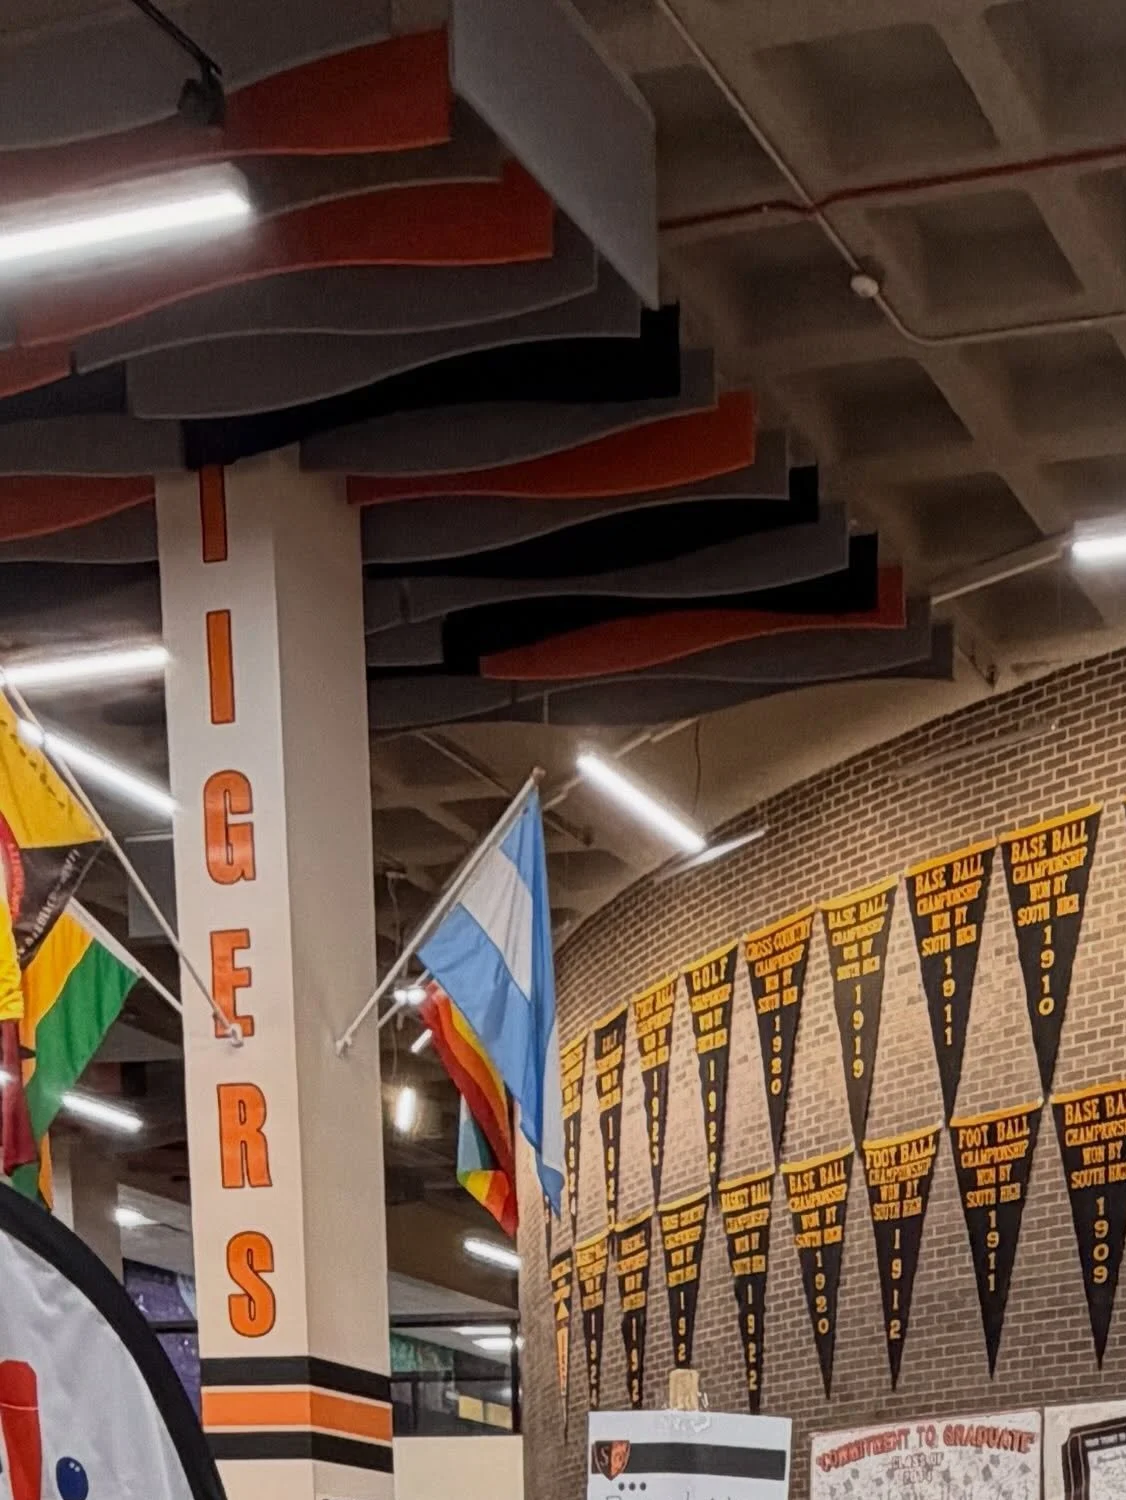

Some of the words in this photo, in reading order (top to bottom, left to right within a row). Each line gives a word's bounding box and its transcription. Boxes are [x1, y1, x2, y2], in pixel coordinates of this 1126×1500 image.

[1011, 833, 1047, 864] BASE
[1052, 820, 1088, 853] BALL
[915, 866, 946, 897] BASE
[952, 854, 984, 884] BALL
[1013, 847, 1087, 885] CHAMPIONSHIP
[917, 880, 982, 916] CHAMPIONSHIP
[1054, 874, 1067, 896] BY
[859, 893, 888, 922] BALL
[1018, 902, 1050, 926] SOUTH
[922, 933, 950, 956] SOUTH
[692, 957, 728, 992] GOLF
[1064, 1098, 1100, 1126] BASE
[959, 1125, 989, 1150] FOOT
[997, 1116, 1030, 1143] BALL
[865, 1147, 897, 1170] FOOT
[900, 1135, 936, 1165] BALL
[961, 1139, 1029, 1169] CHAMPIONSHIP
[1082, 1144, 1105, 1166] WON
[1108, 1141, 1123, 1162] BY
[789, 1171, 816, 1195] BASE
[820, 1159, 847, 1185] BALL
[869, 1156, 932, 1187] CHAMPIONSHIP
[999, 1164, 1012, 1182] BY
[1071, 1168, 1105, 1190] SOUTH
[966, 1188, 996, 1209] SOUTH
[916, 1424, 937, 1448] TO
